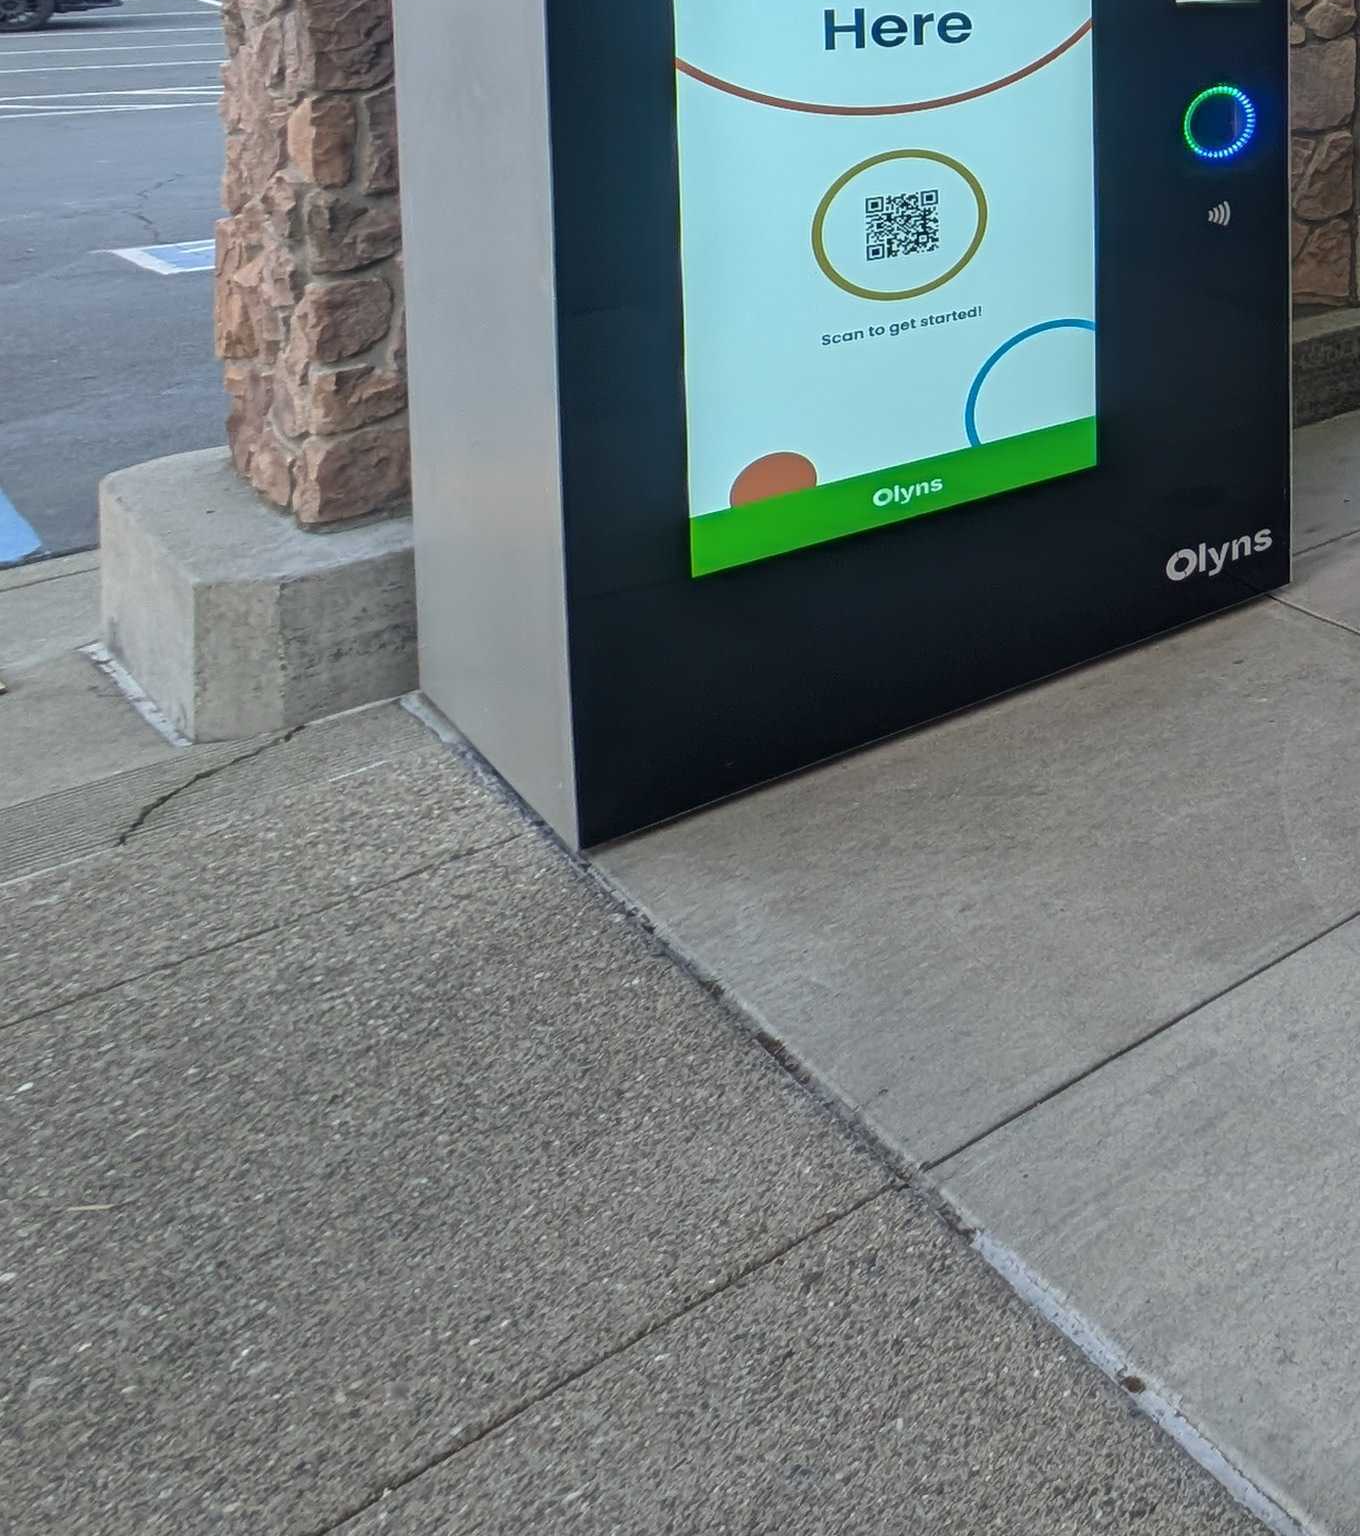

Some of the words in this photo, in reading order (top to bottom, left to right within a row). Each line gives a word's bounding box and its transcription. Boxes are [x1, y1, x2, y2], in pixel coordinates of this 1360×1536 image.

[824, 7, 973, 51] Here
[821, 330, 864, 346] Scan
[868, 326, 885, 337] to
[889, 318, 917, 336] get
[920, 305, 983, 327] started!
[872, 478, 943, 507] Olyns
[1165, 528, 1273, 581] Olyns
